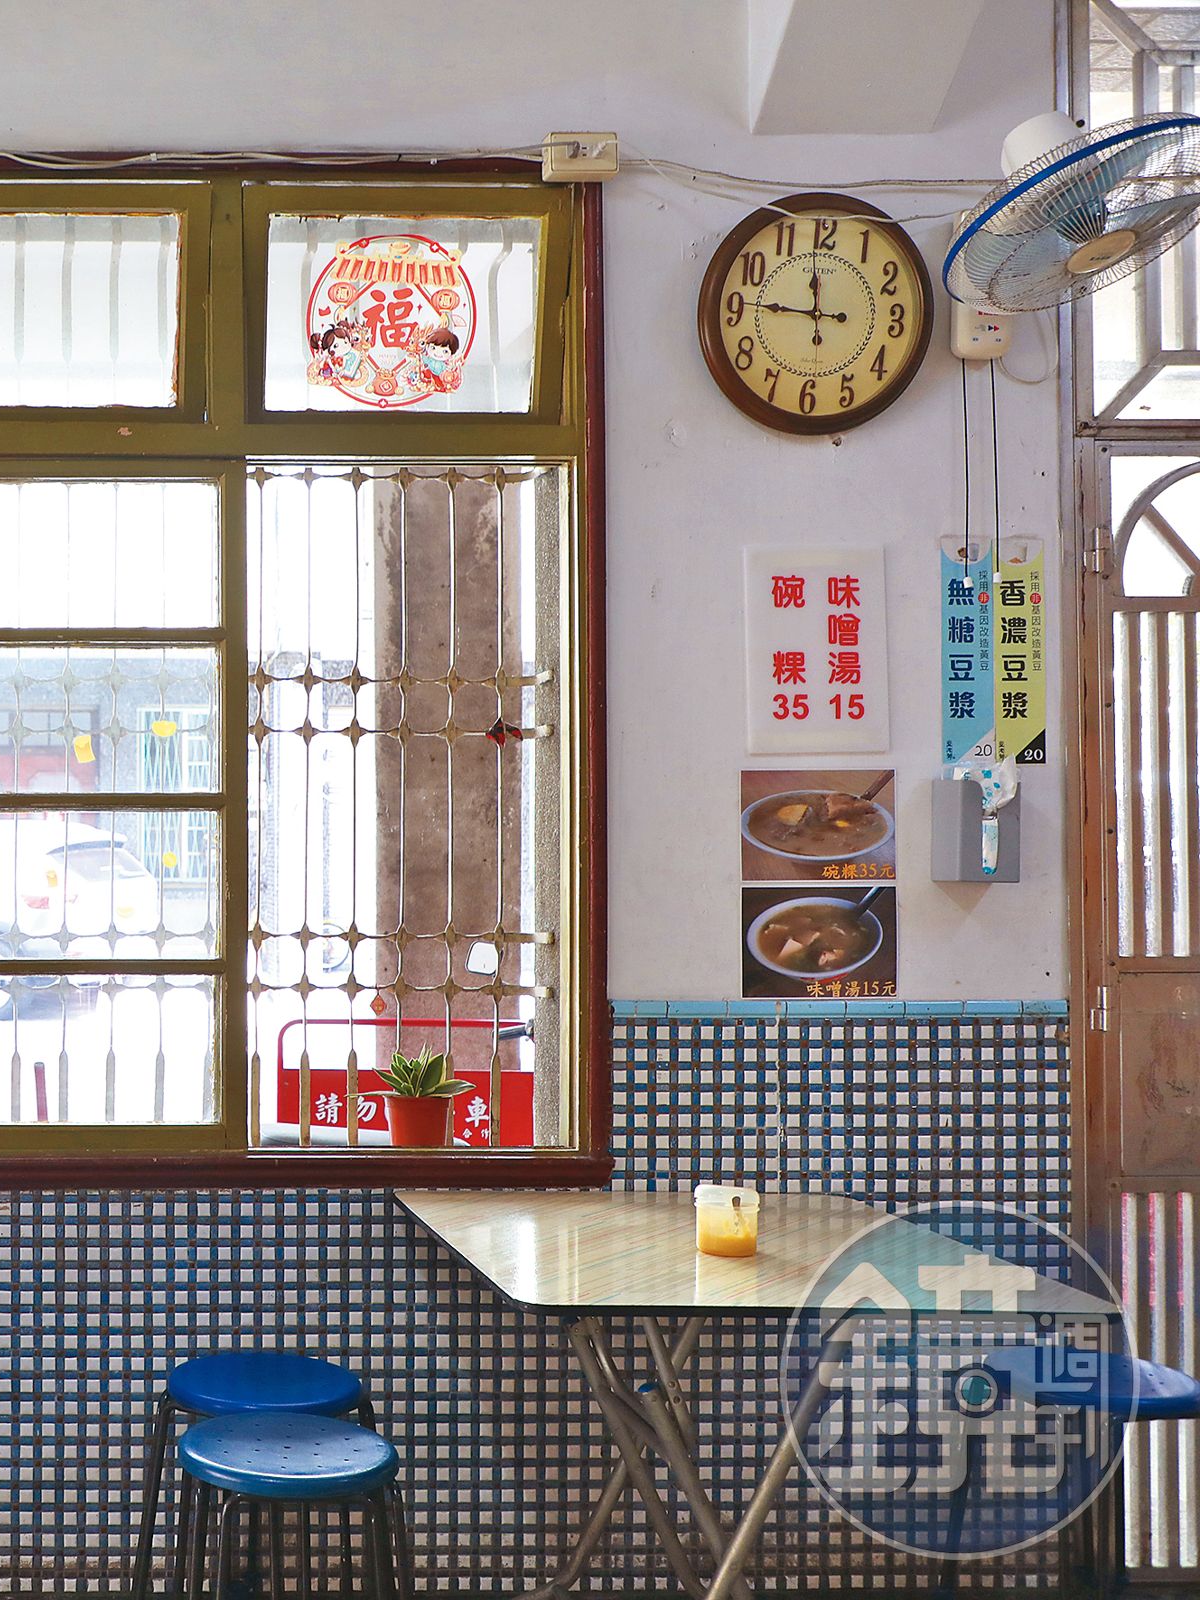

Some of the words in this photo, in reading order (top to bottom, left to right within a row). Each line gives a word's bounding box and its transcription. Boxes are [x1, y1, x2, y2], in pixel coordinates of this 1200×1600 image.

[774, 221, 795, 256] 11
[814, 216, 837, 250] 12
[859, 229, 869, 263] 1
[740, 251, 765, 287] 10
[880, 261, 898, 296] 2
[363, 287, 419, 350] 福
[726, 291, 744, 327] 9
[888, 303, 905, 338] 3
[735, 335, 754, 371] 8
[870, 345, 887, 381] 4
[764, 368, 781, 403] 7
[799, 379, 816, 414] 6
[839, 373, 855, 408] 5
[827, 574, 861, 685] 味噌湯
[947, 578, 975, 718] 無糖豆漿
[1000, 580, 1028, 718] 香濃豆漿
[772, 694, 809, 720] 35
[829, 694, 865, 720] 15
[974, 744, 993, 757] 20
[1024, 749, 1044, 761] 20
[821, 863, 895, 879] 碗粿35元
[806, 981, 896, 997] 味噌湯15元
[315, 1093, 490, 1128] 請勿車
